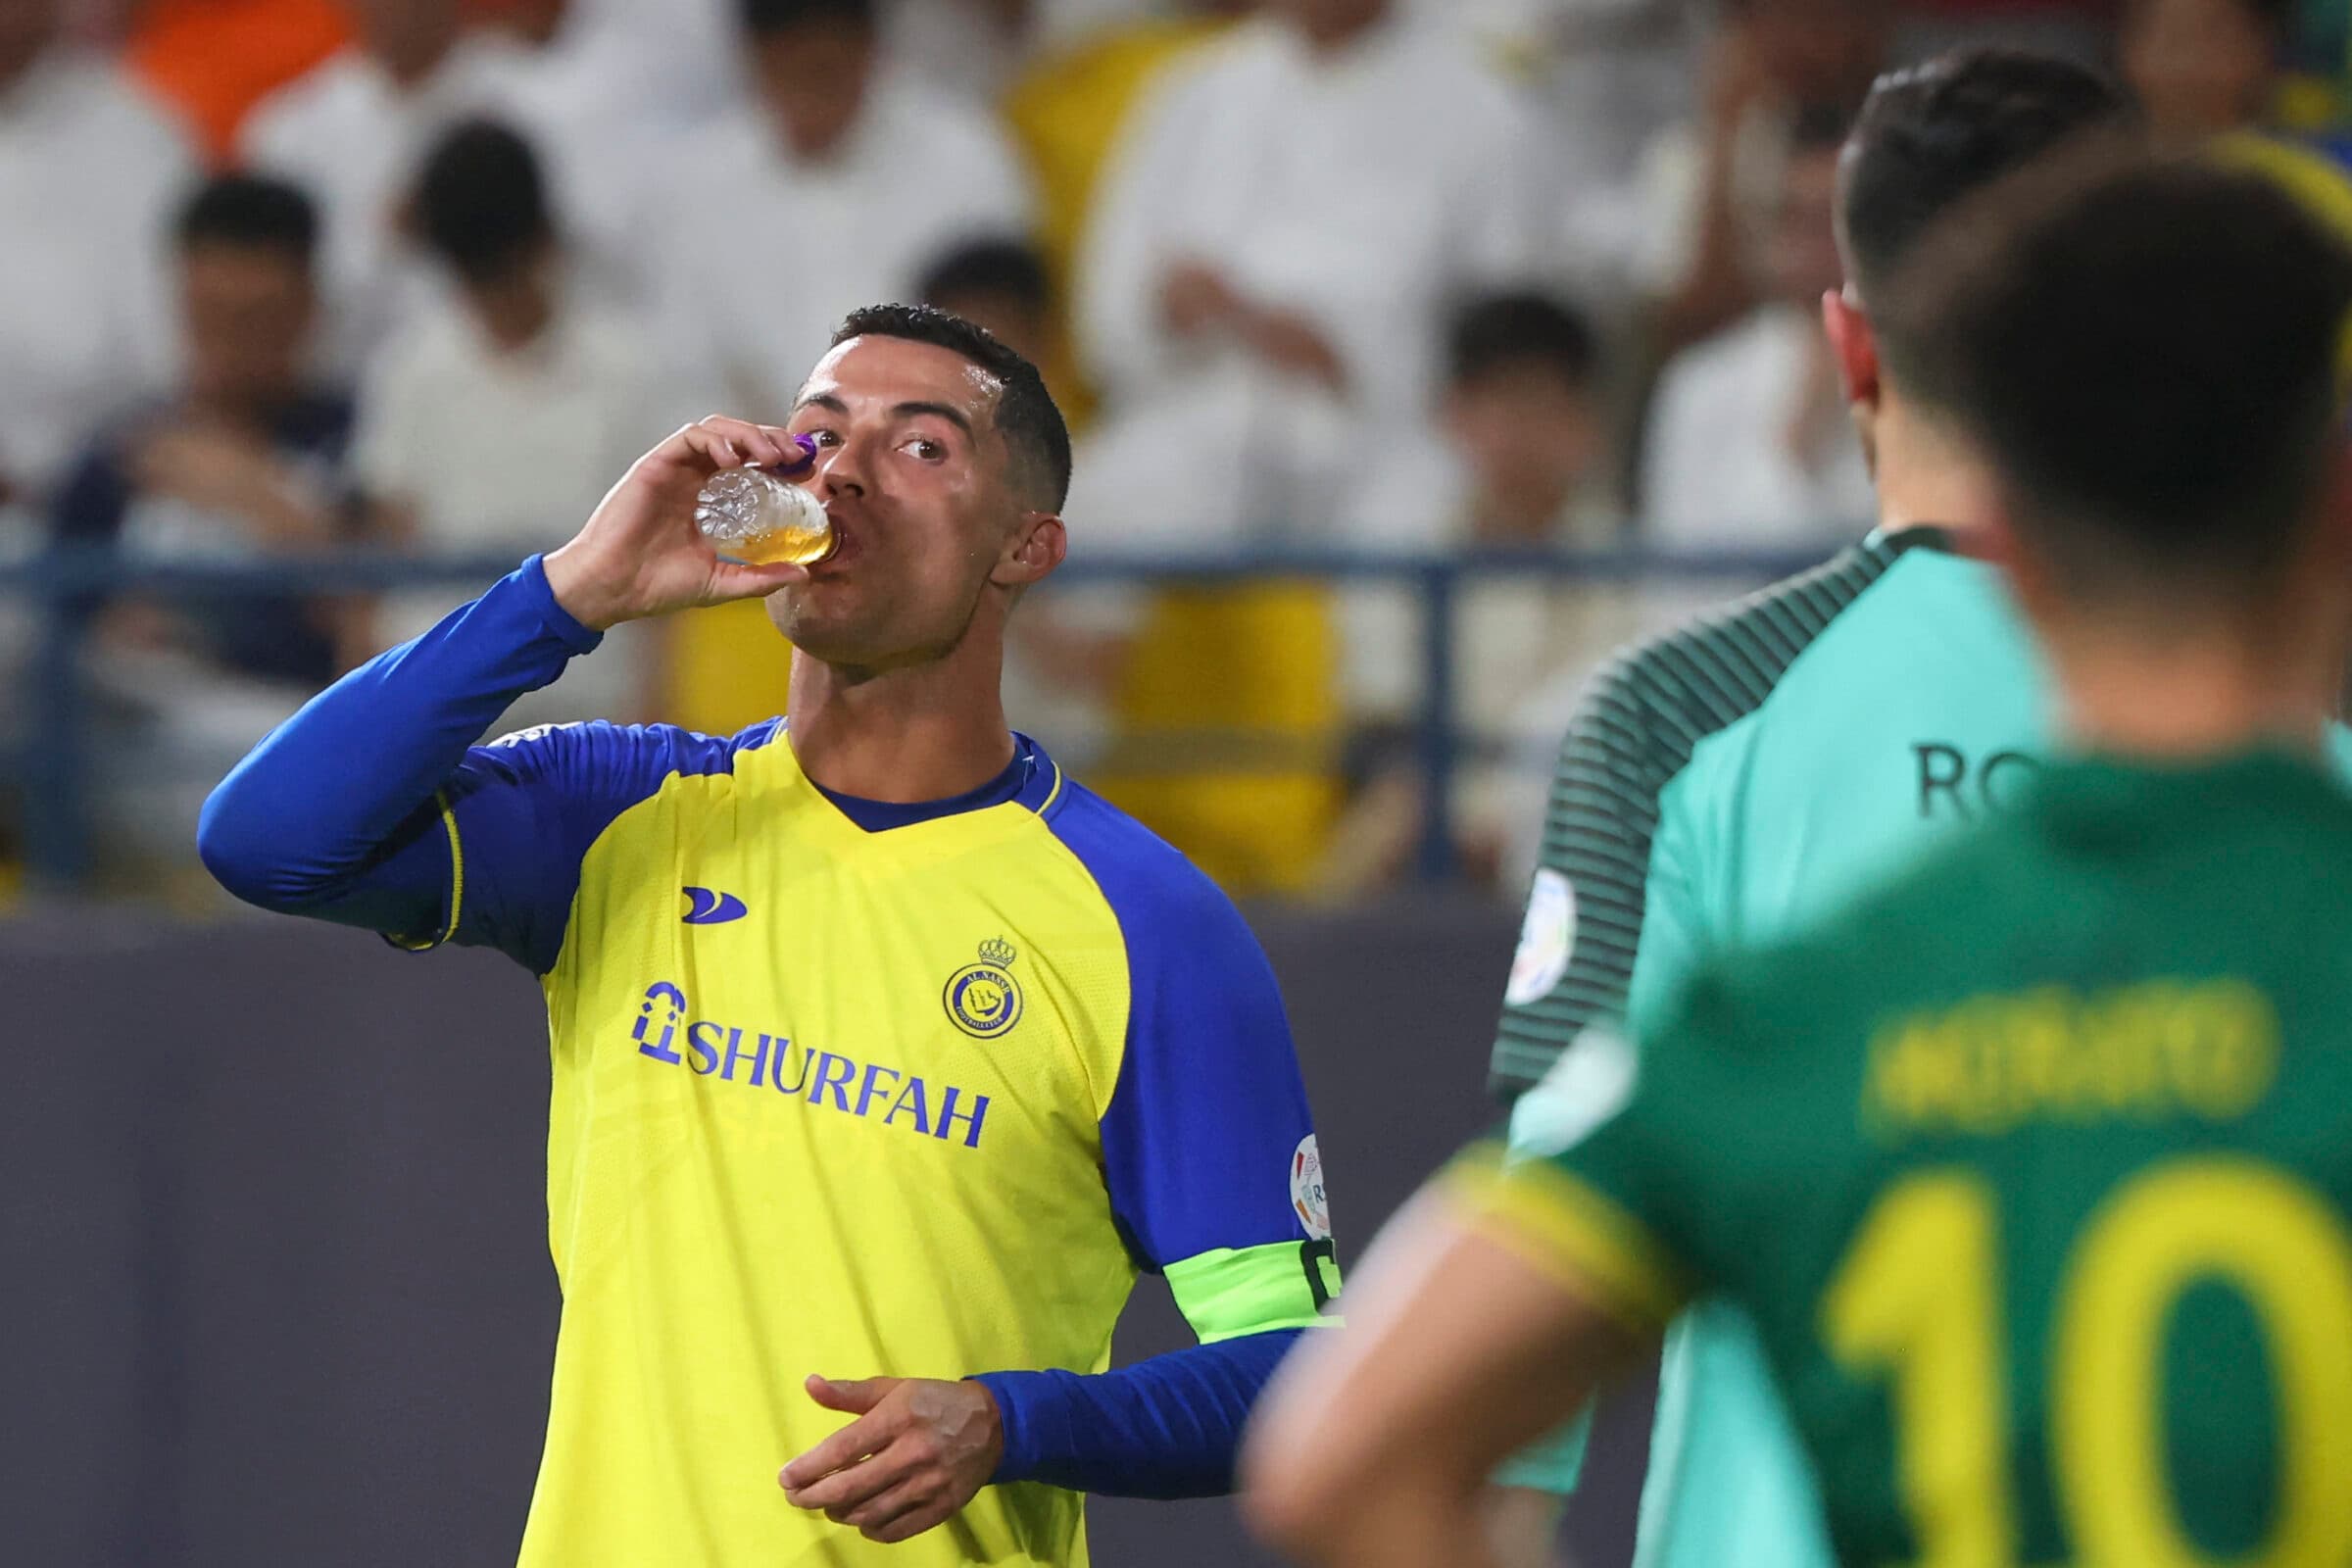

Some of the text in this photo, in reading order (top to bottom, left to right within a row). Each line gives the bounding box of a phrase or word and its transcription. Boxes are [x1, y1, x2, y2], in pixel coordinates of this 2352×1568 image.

[967, 971, 1010, 994] AL NASSR
[687, 1021, 990, 1148] SHURFAH
[1819, 1153, 2352, 1568] 10
